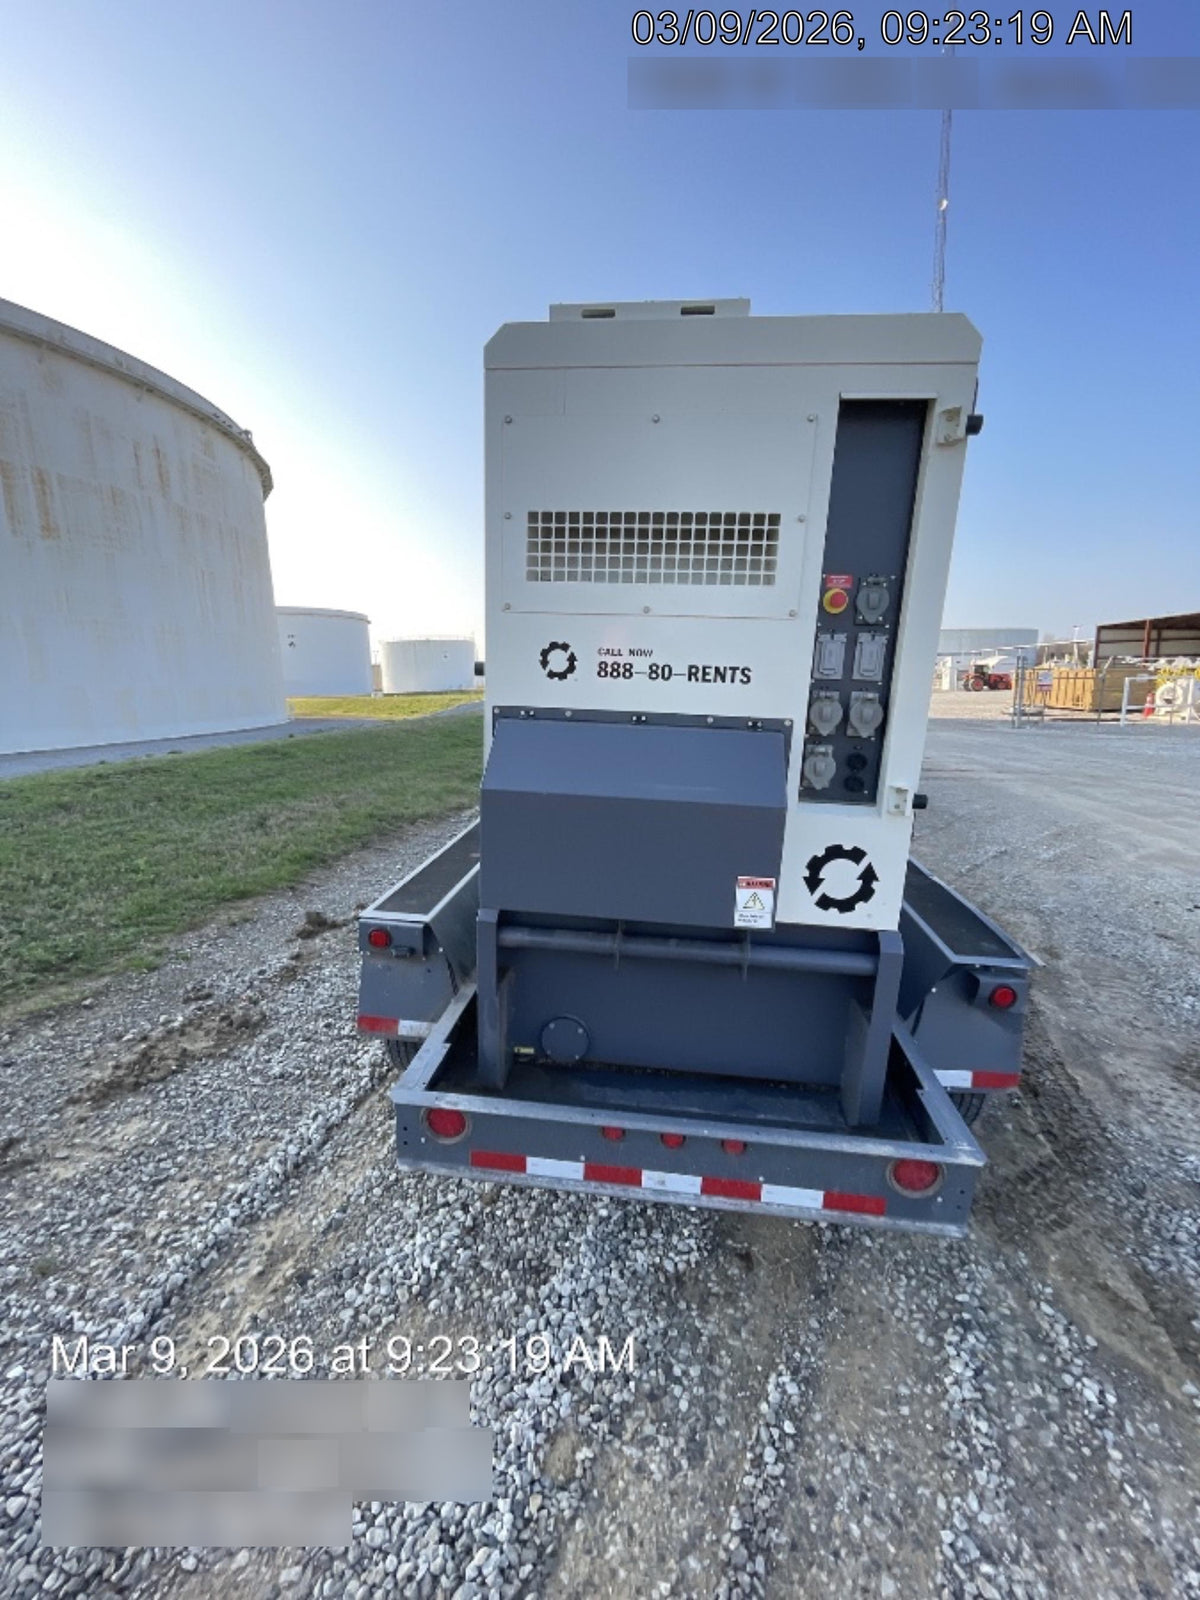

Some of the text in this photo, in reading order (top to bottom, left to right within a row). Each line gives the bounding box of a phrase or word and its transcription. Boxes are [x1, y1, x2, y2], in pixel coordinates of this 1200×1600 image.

[597, 647, 653, 657] CALL NOW
[597, 661, 752, 685] 888-80-RENTS
